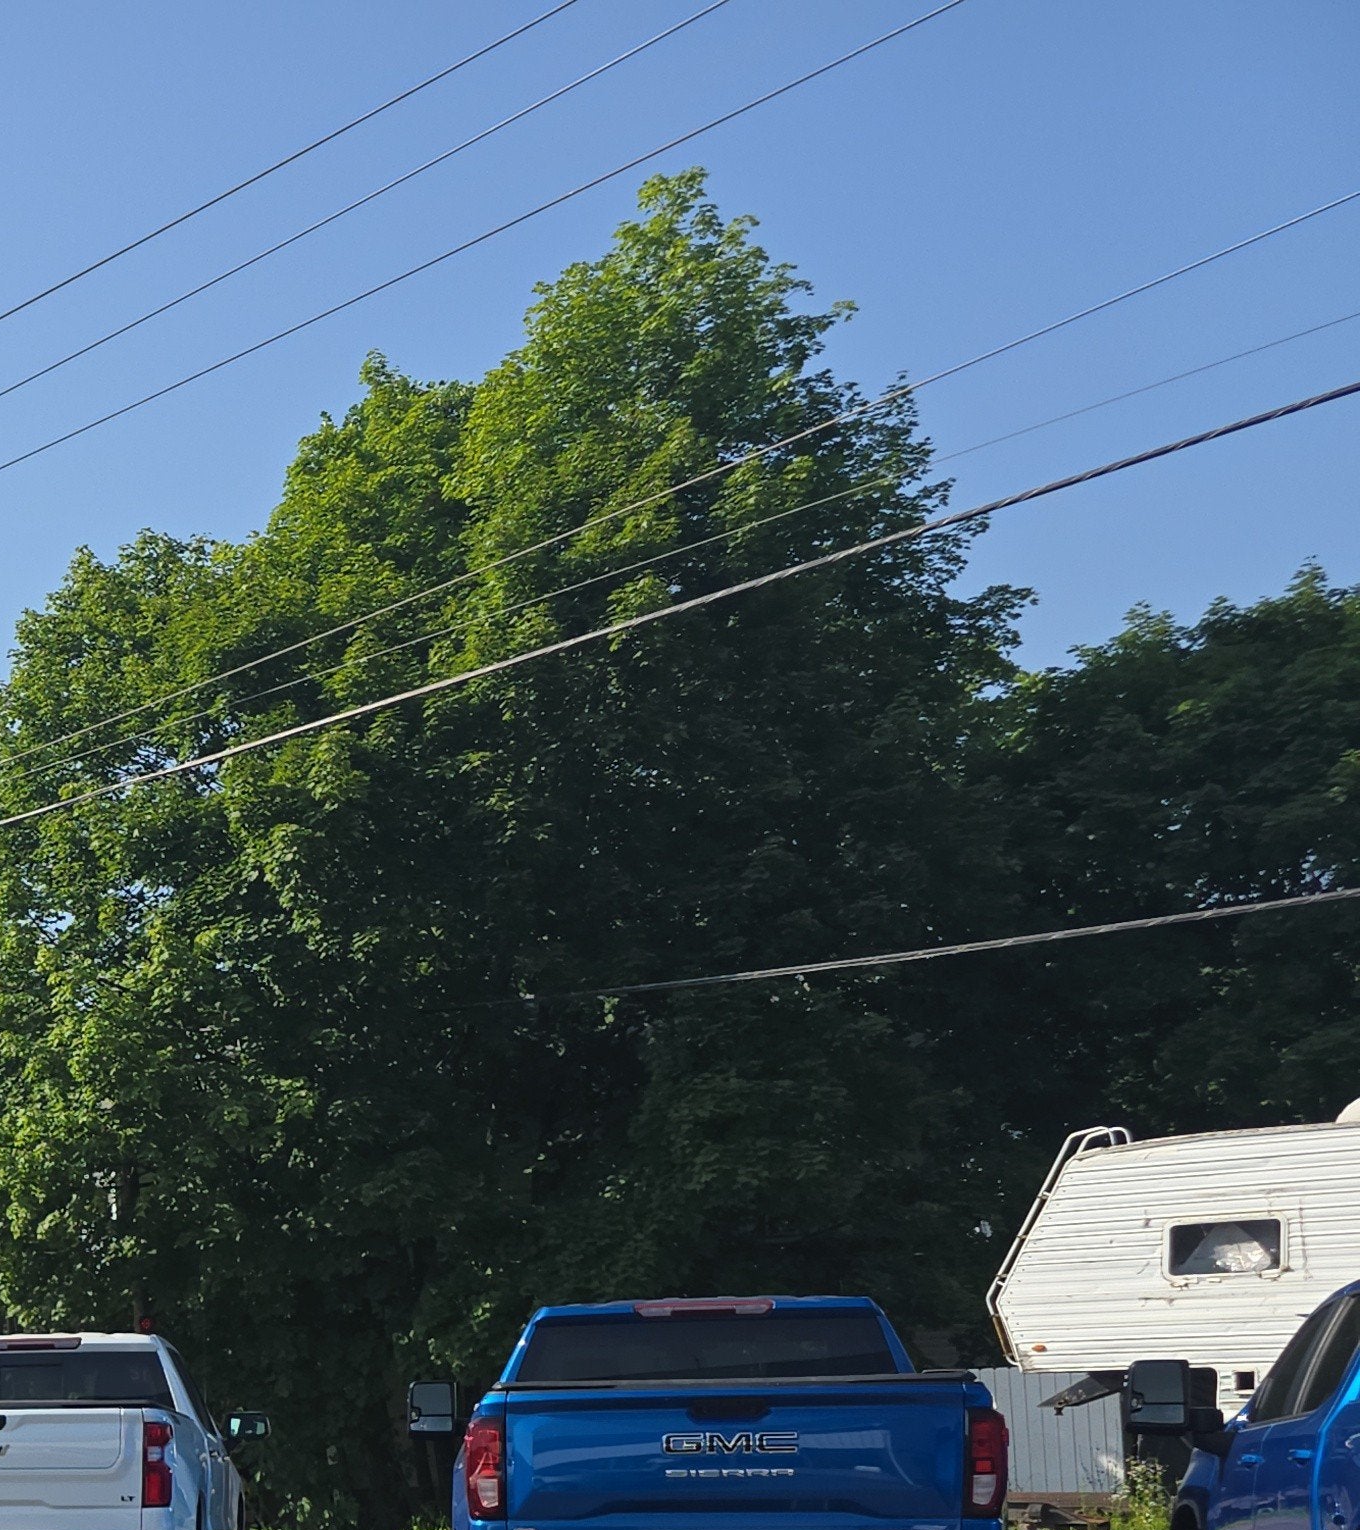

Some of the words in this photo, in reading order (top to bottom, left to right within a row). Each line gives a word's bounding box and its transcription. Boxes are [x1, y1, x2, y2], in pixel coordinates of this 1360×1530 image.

[662, 1431, 798, 1455] GMC
[664, 1468, 795, 1478] SIERRA
[120, 1494, 136, 1502] LT
